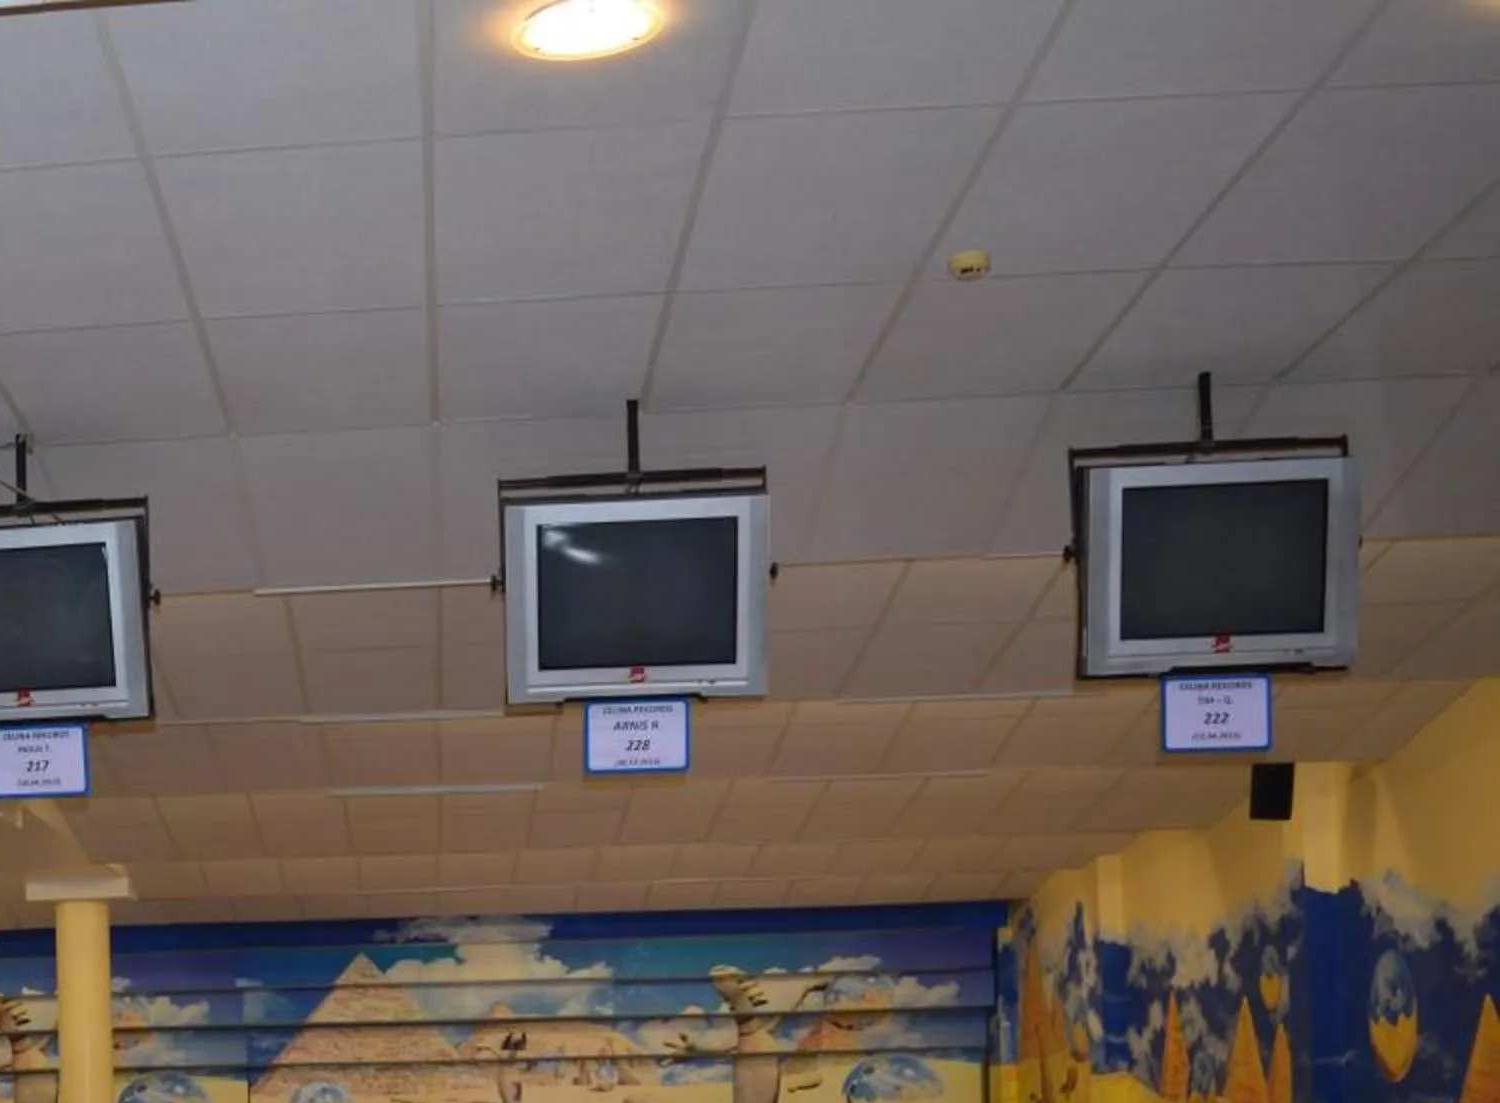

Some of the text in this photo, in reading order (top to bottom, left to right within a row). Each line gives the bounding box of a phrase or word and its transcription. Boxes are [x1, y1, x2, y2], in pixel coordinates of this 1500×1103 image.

[1203, 711, 1231, 725] 222
[625, 739, 652, 752] 228
[25, 759, 51, 773] 217
